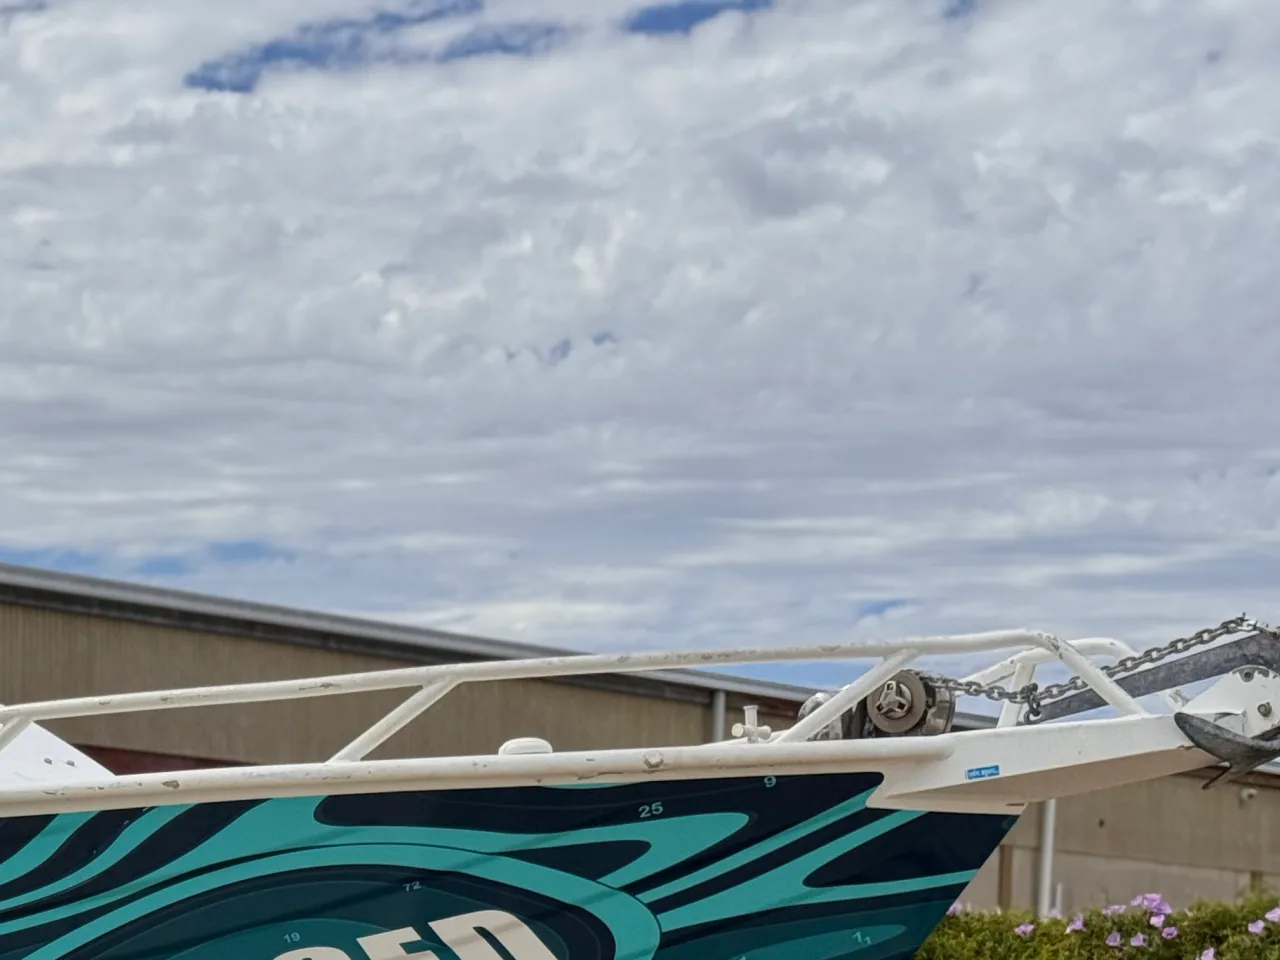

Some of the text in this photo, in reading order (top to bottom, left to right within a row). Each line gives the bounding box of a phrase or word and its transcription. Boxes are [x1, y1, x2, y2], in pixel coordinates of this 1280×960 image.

[762, 775, 775, 788] 9
[638, 801, 663, 818] 25
[402, 881, 421, 891] 72
[283, 932, 299, 943] 19
